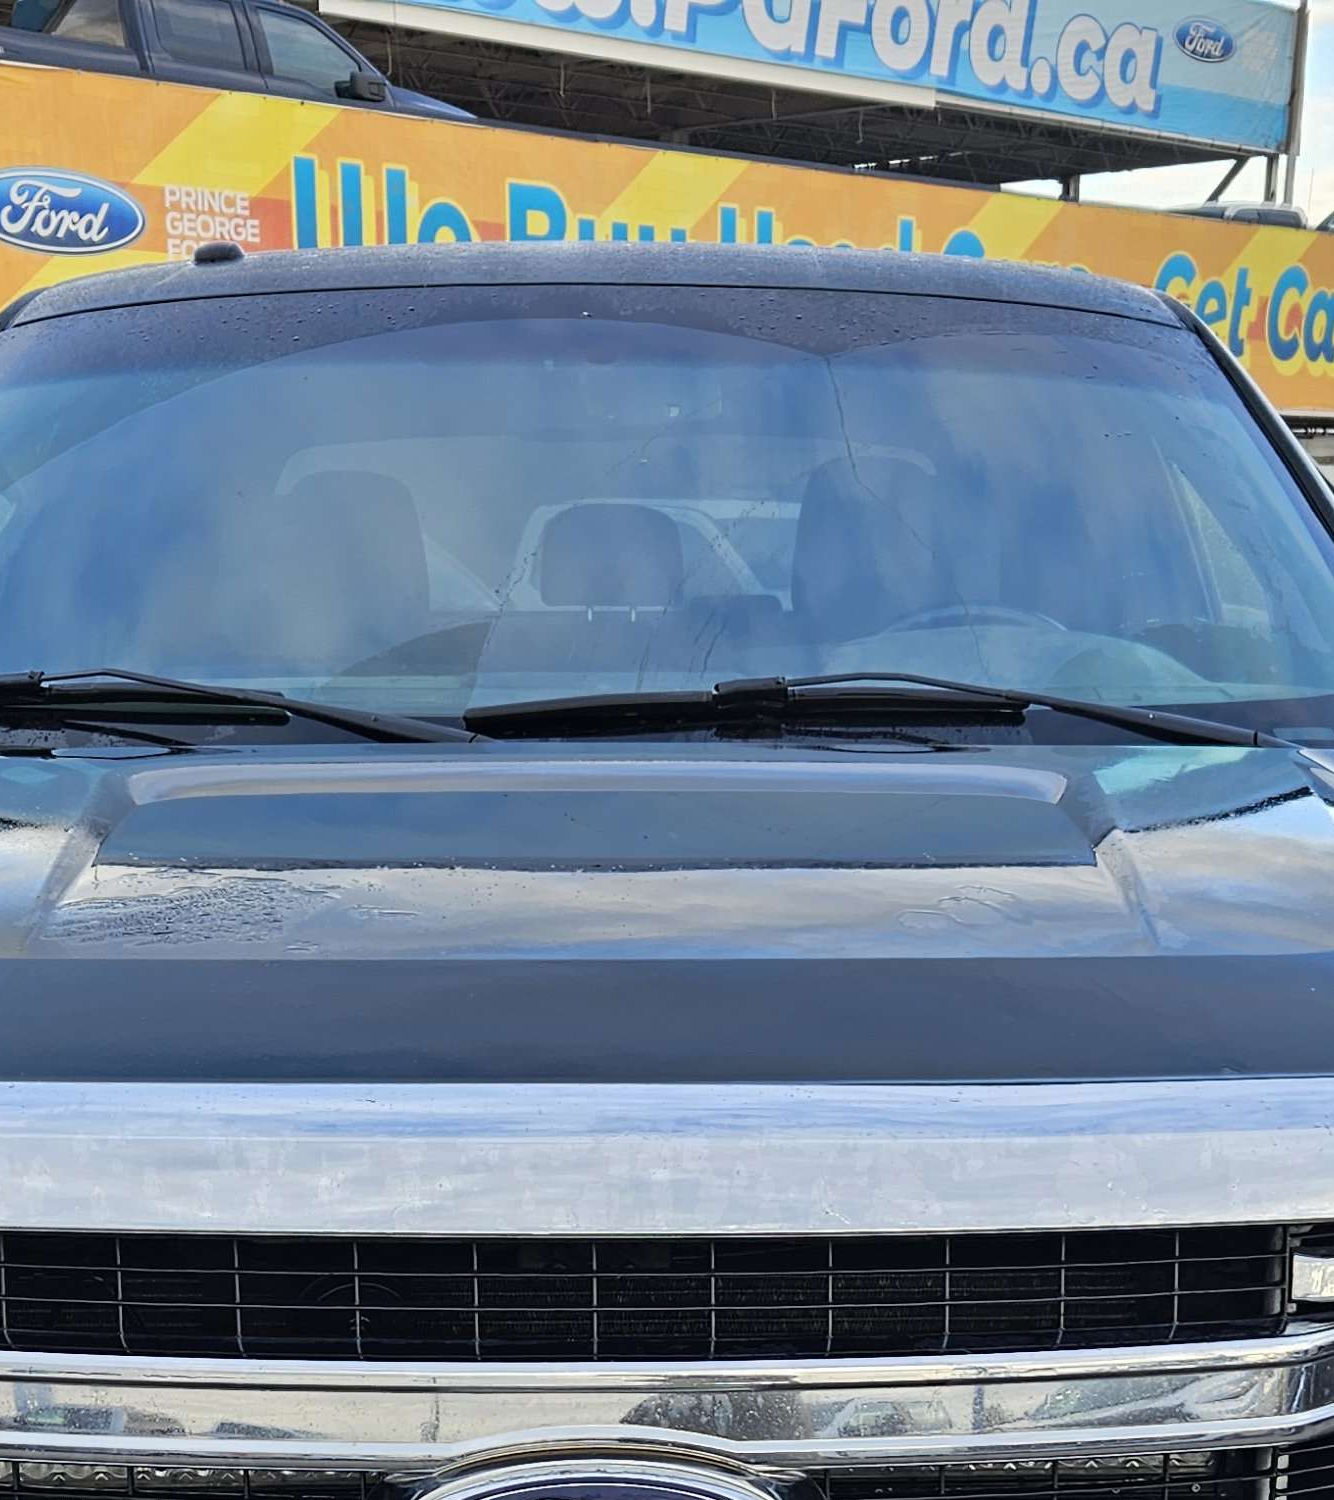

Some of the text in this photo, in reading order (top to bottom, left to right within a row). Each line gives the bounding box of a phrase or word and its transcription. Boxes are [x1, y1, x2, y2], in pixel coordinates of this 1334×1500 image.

[1184, 22, 1225, 57] Ford
[0, 179, 110, 242] Ford
[164, 185, 251, 216] PRINCE
[166, 211, 260, 243] GEORGE
